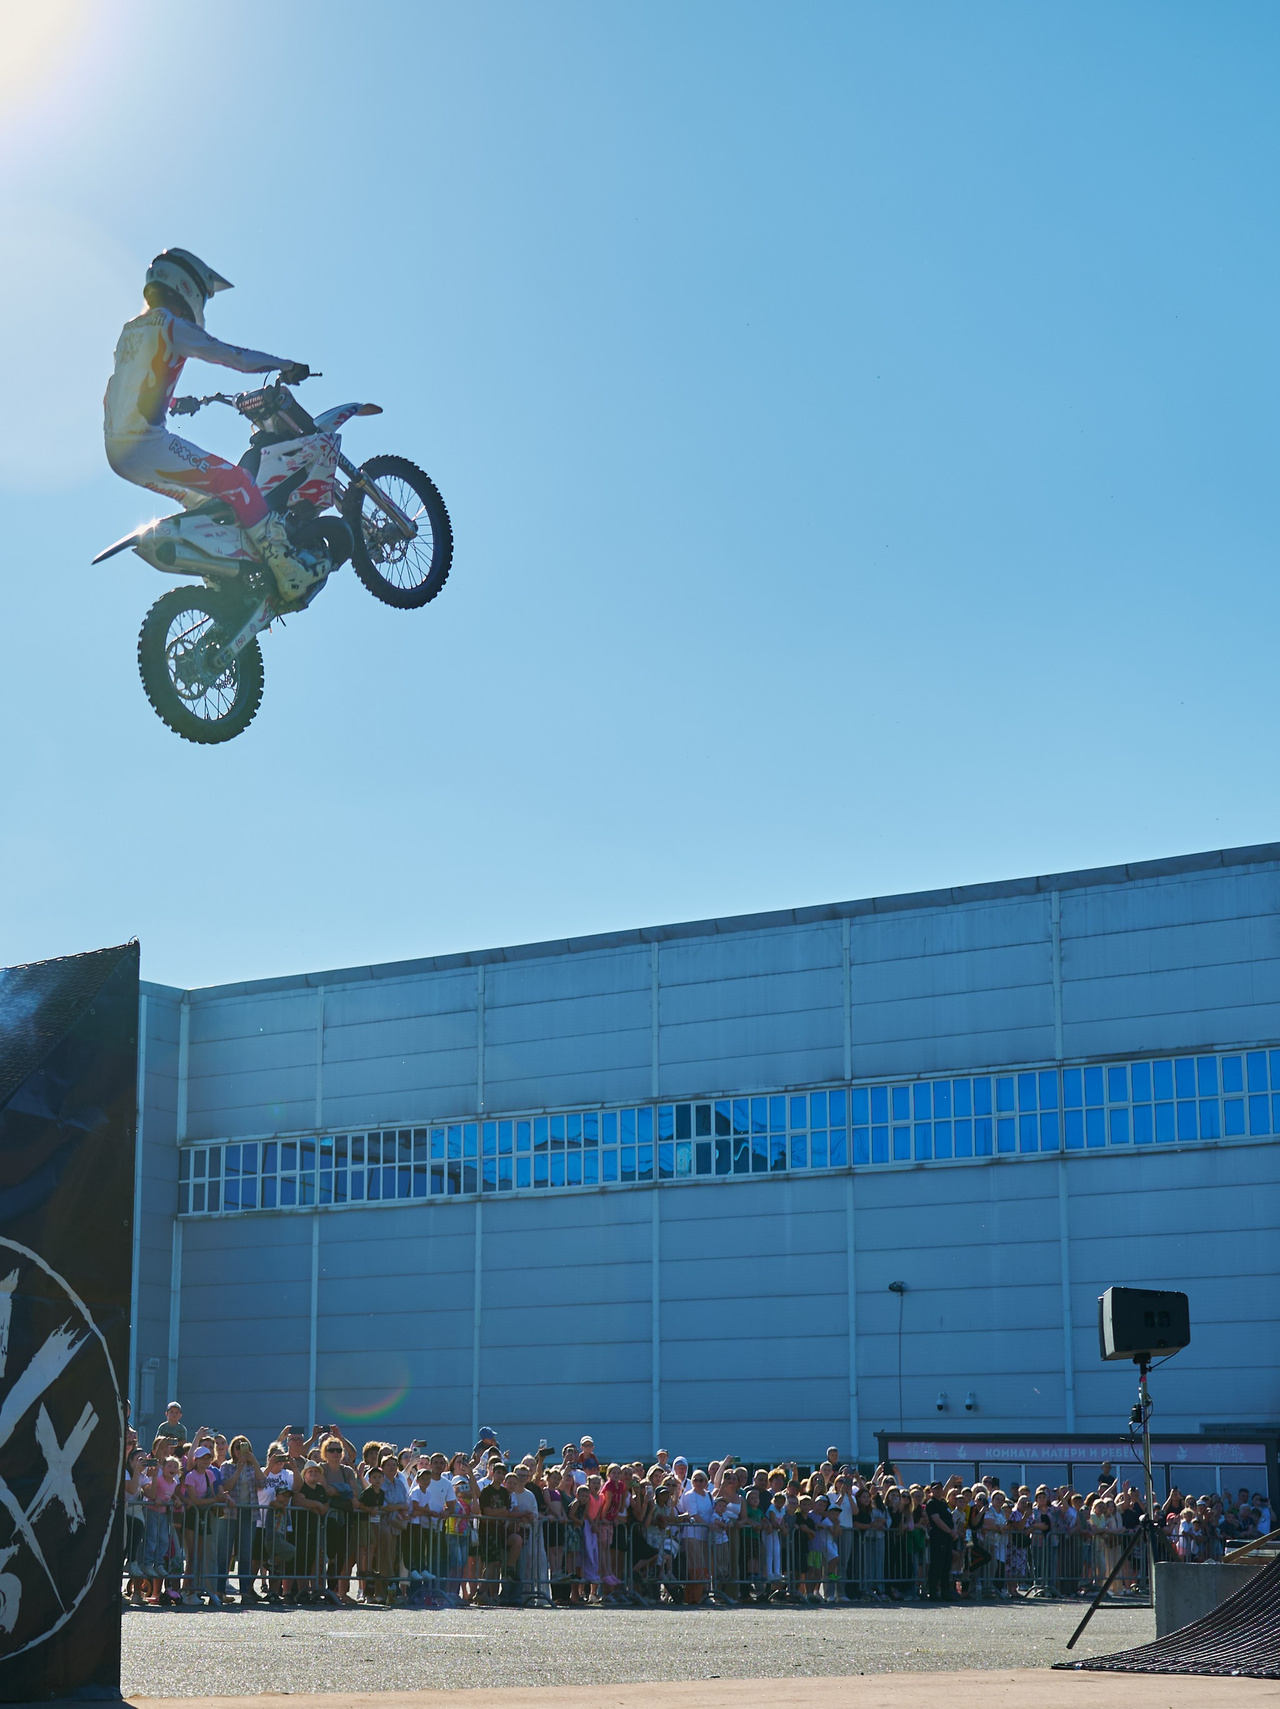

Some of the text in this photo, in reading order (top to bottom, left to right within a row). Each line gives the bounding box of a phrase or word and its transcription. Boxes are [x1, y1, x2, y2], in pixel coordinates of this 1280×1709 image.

[985, 1446, 1154, 1460] КОМНАТА МАТЕРИ И РЕБЁНК
